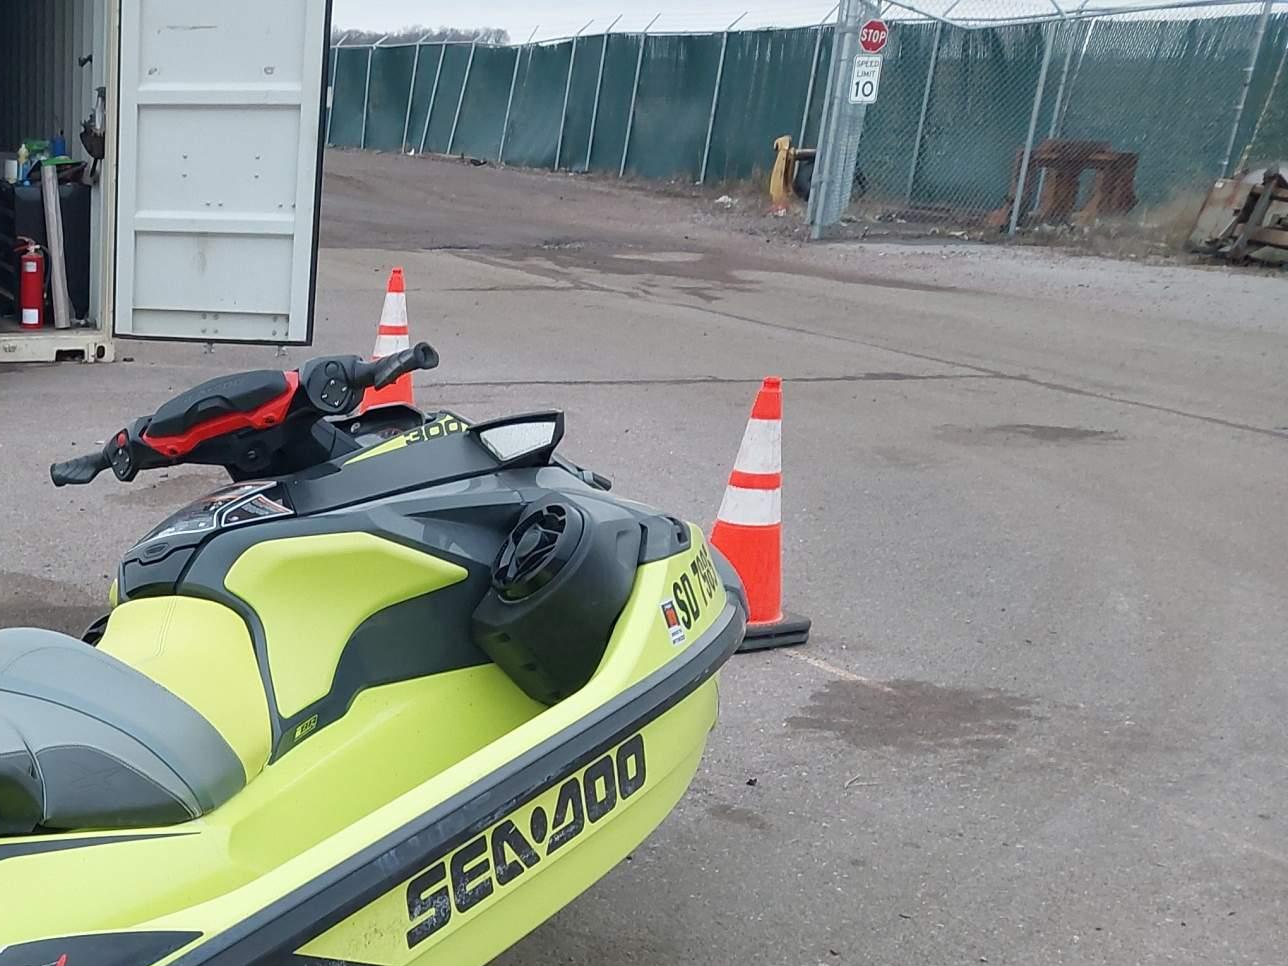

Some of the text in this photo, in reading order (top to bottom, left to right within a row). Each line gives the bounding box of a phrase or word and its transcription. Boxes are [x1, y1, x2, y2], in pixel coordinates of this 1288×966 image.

[861, 29, 886, 43] STOP
[856, 70, 876, 78] LIMIT
[854, 80, 874, 97] 10
[406, 419, 463, 445] 300
[673, 573, 701, 630] SD
